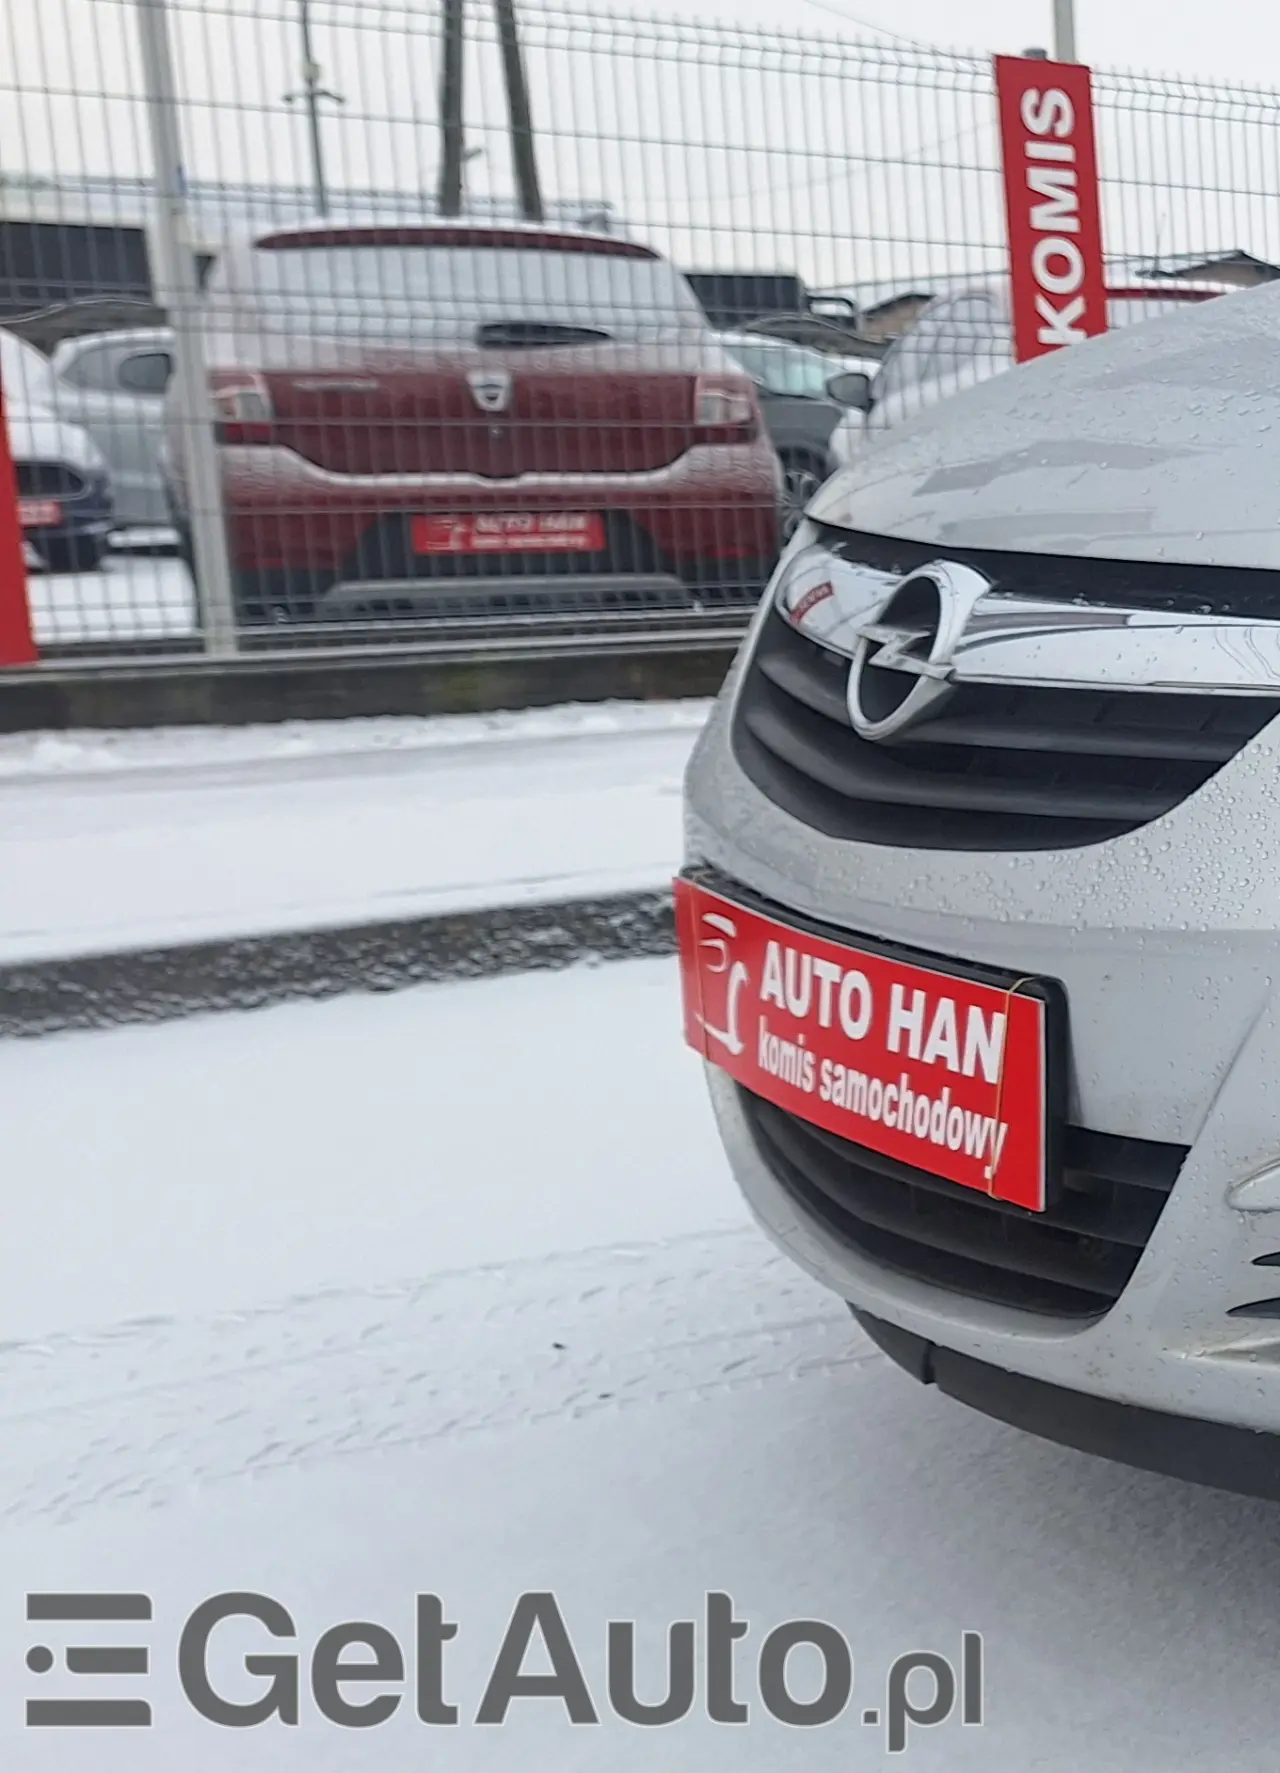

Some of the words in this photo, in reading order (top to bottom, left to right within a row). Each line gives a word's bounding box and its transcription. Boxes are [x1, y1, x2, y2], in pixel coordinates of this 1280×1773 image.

[1020, 86, 1088, 346] KOMIS
[759, 940, 873, 1041] AUTO
[886, 982, 1008, 1085] HAN
[757, 1015, 816, 1093] komis
[819, 1058, 1008, 1180] samochodowy
